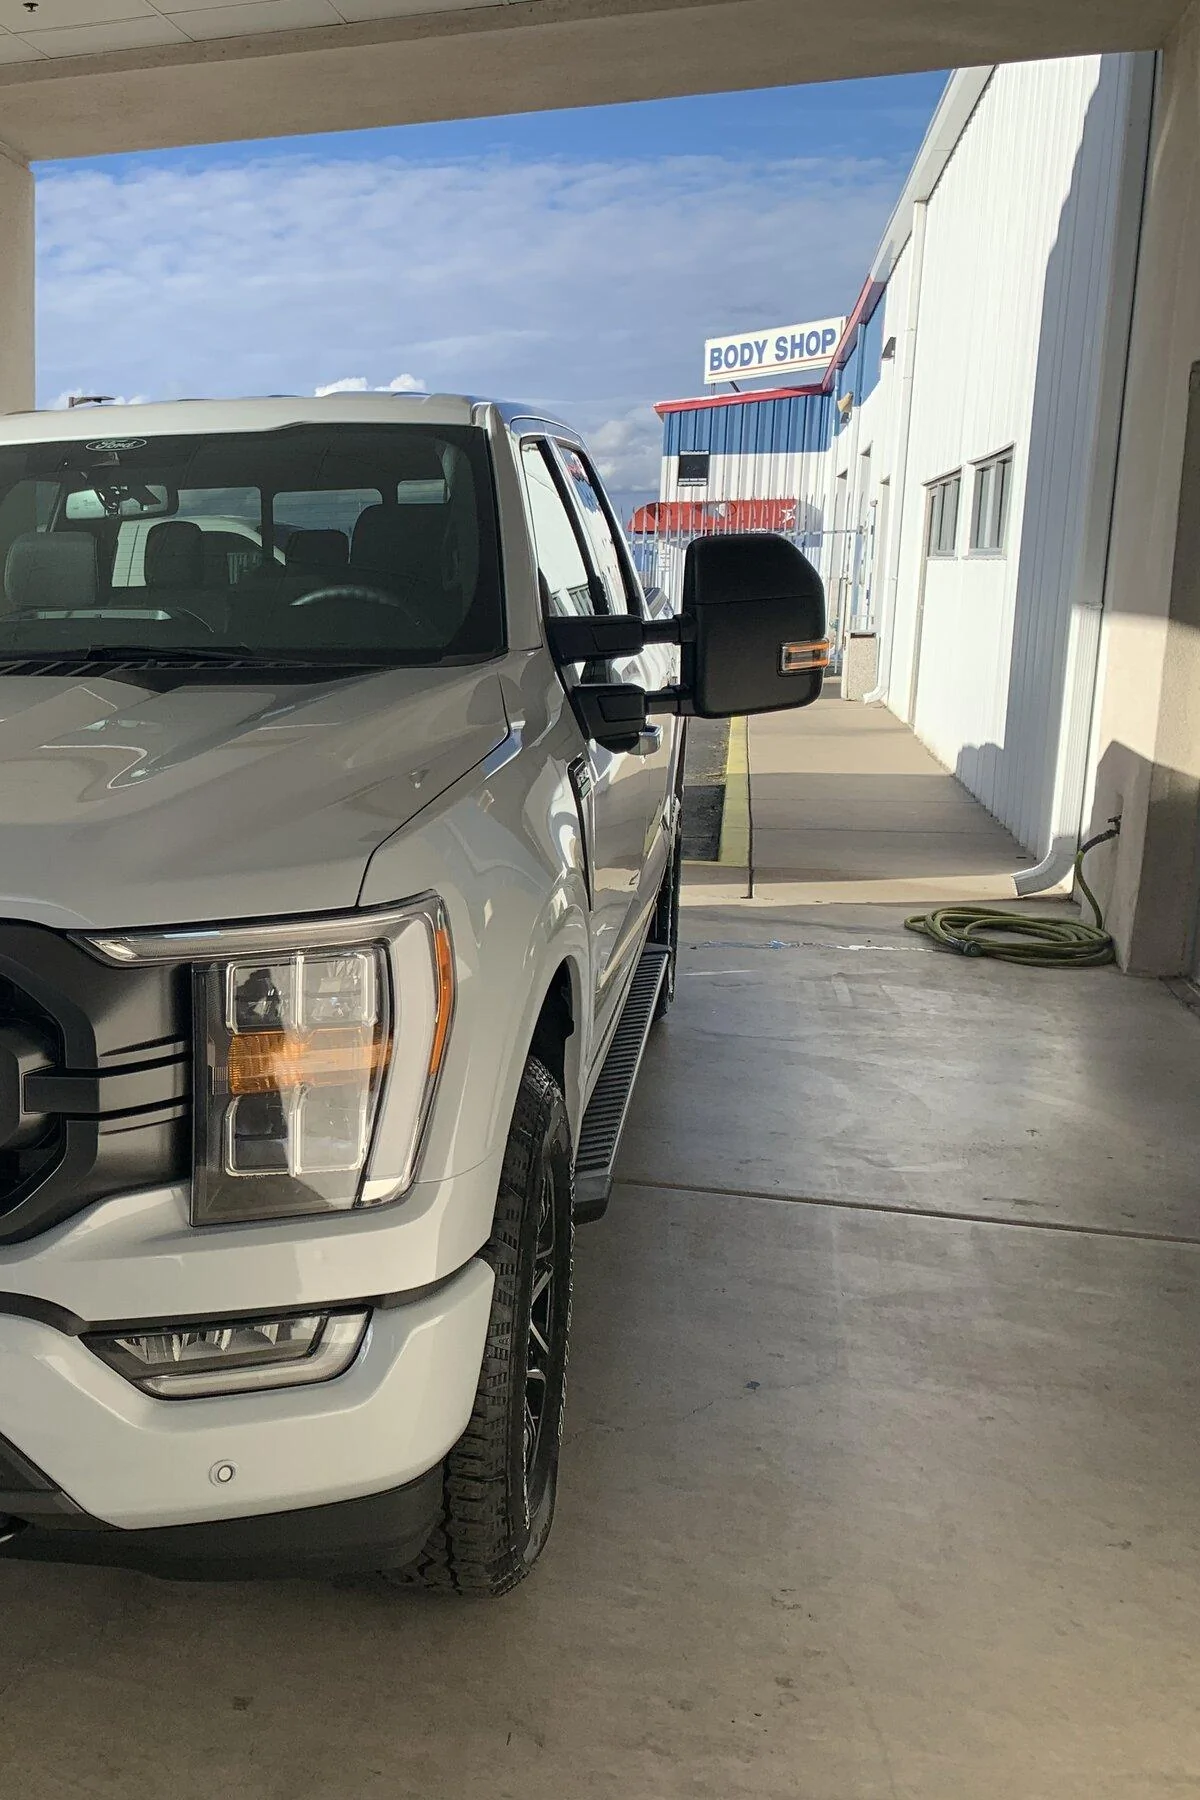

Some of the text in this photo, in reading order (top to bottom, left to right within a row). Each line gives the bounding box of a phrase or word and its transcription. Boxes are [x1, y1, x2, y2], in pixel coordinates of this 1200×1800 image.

[709, 328, 837, 372] BODY SHOP
[95, 439, 138, 449] Ford
